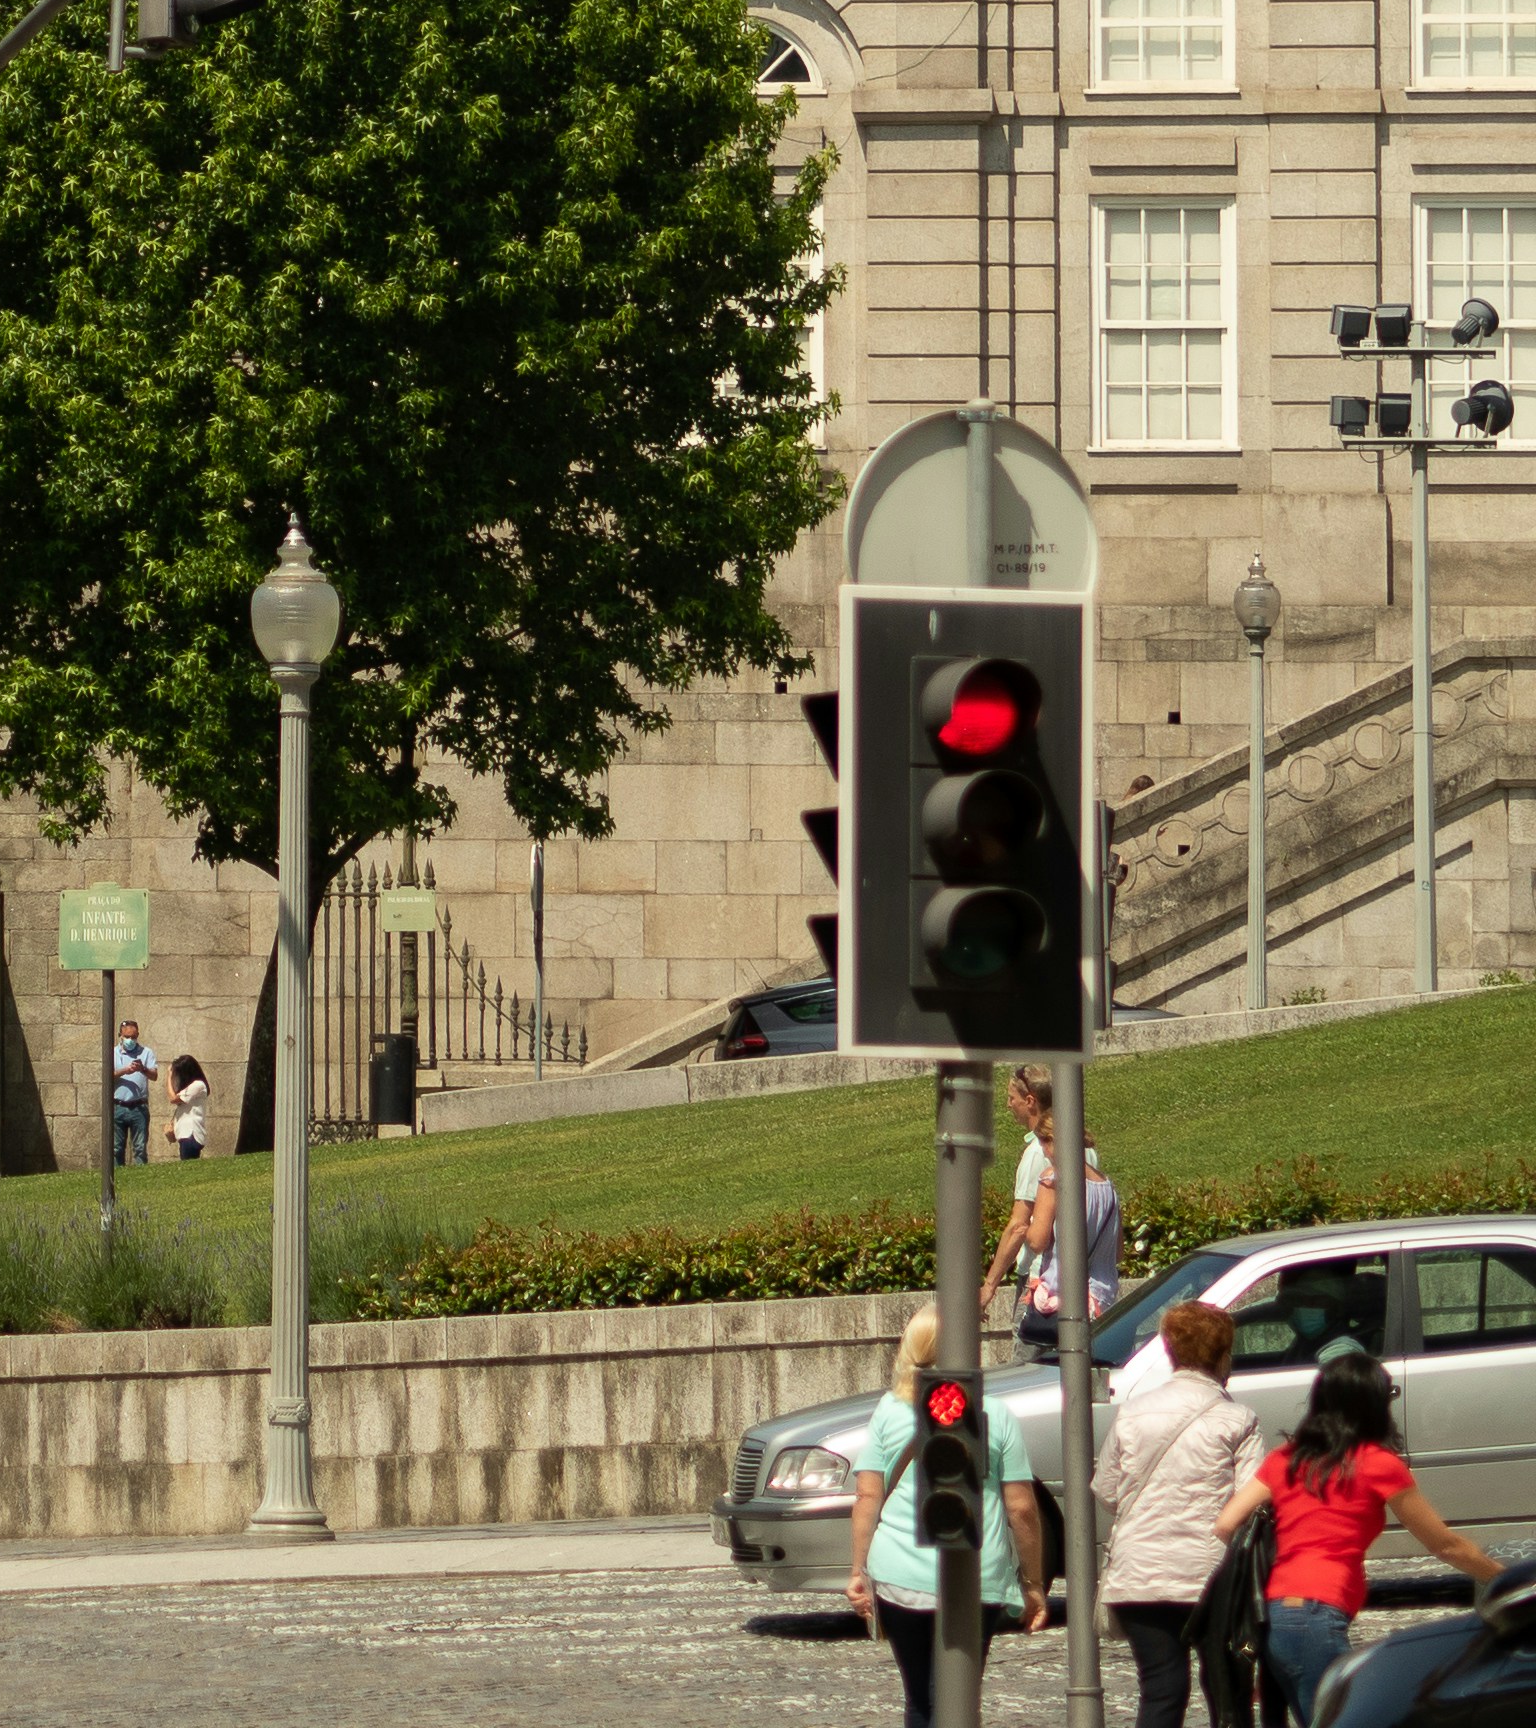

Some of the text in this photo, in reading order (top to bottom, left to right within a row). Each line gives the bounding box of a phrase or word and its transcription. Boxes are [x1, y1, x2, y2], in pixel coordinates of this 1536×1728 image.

[82, 910, 126, 925] INFANTE
[70, 927, 137, 944] D. HENRIQUE
